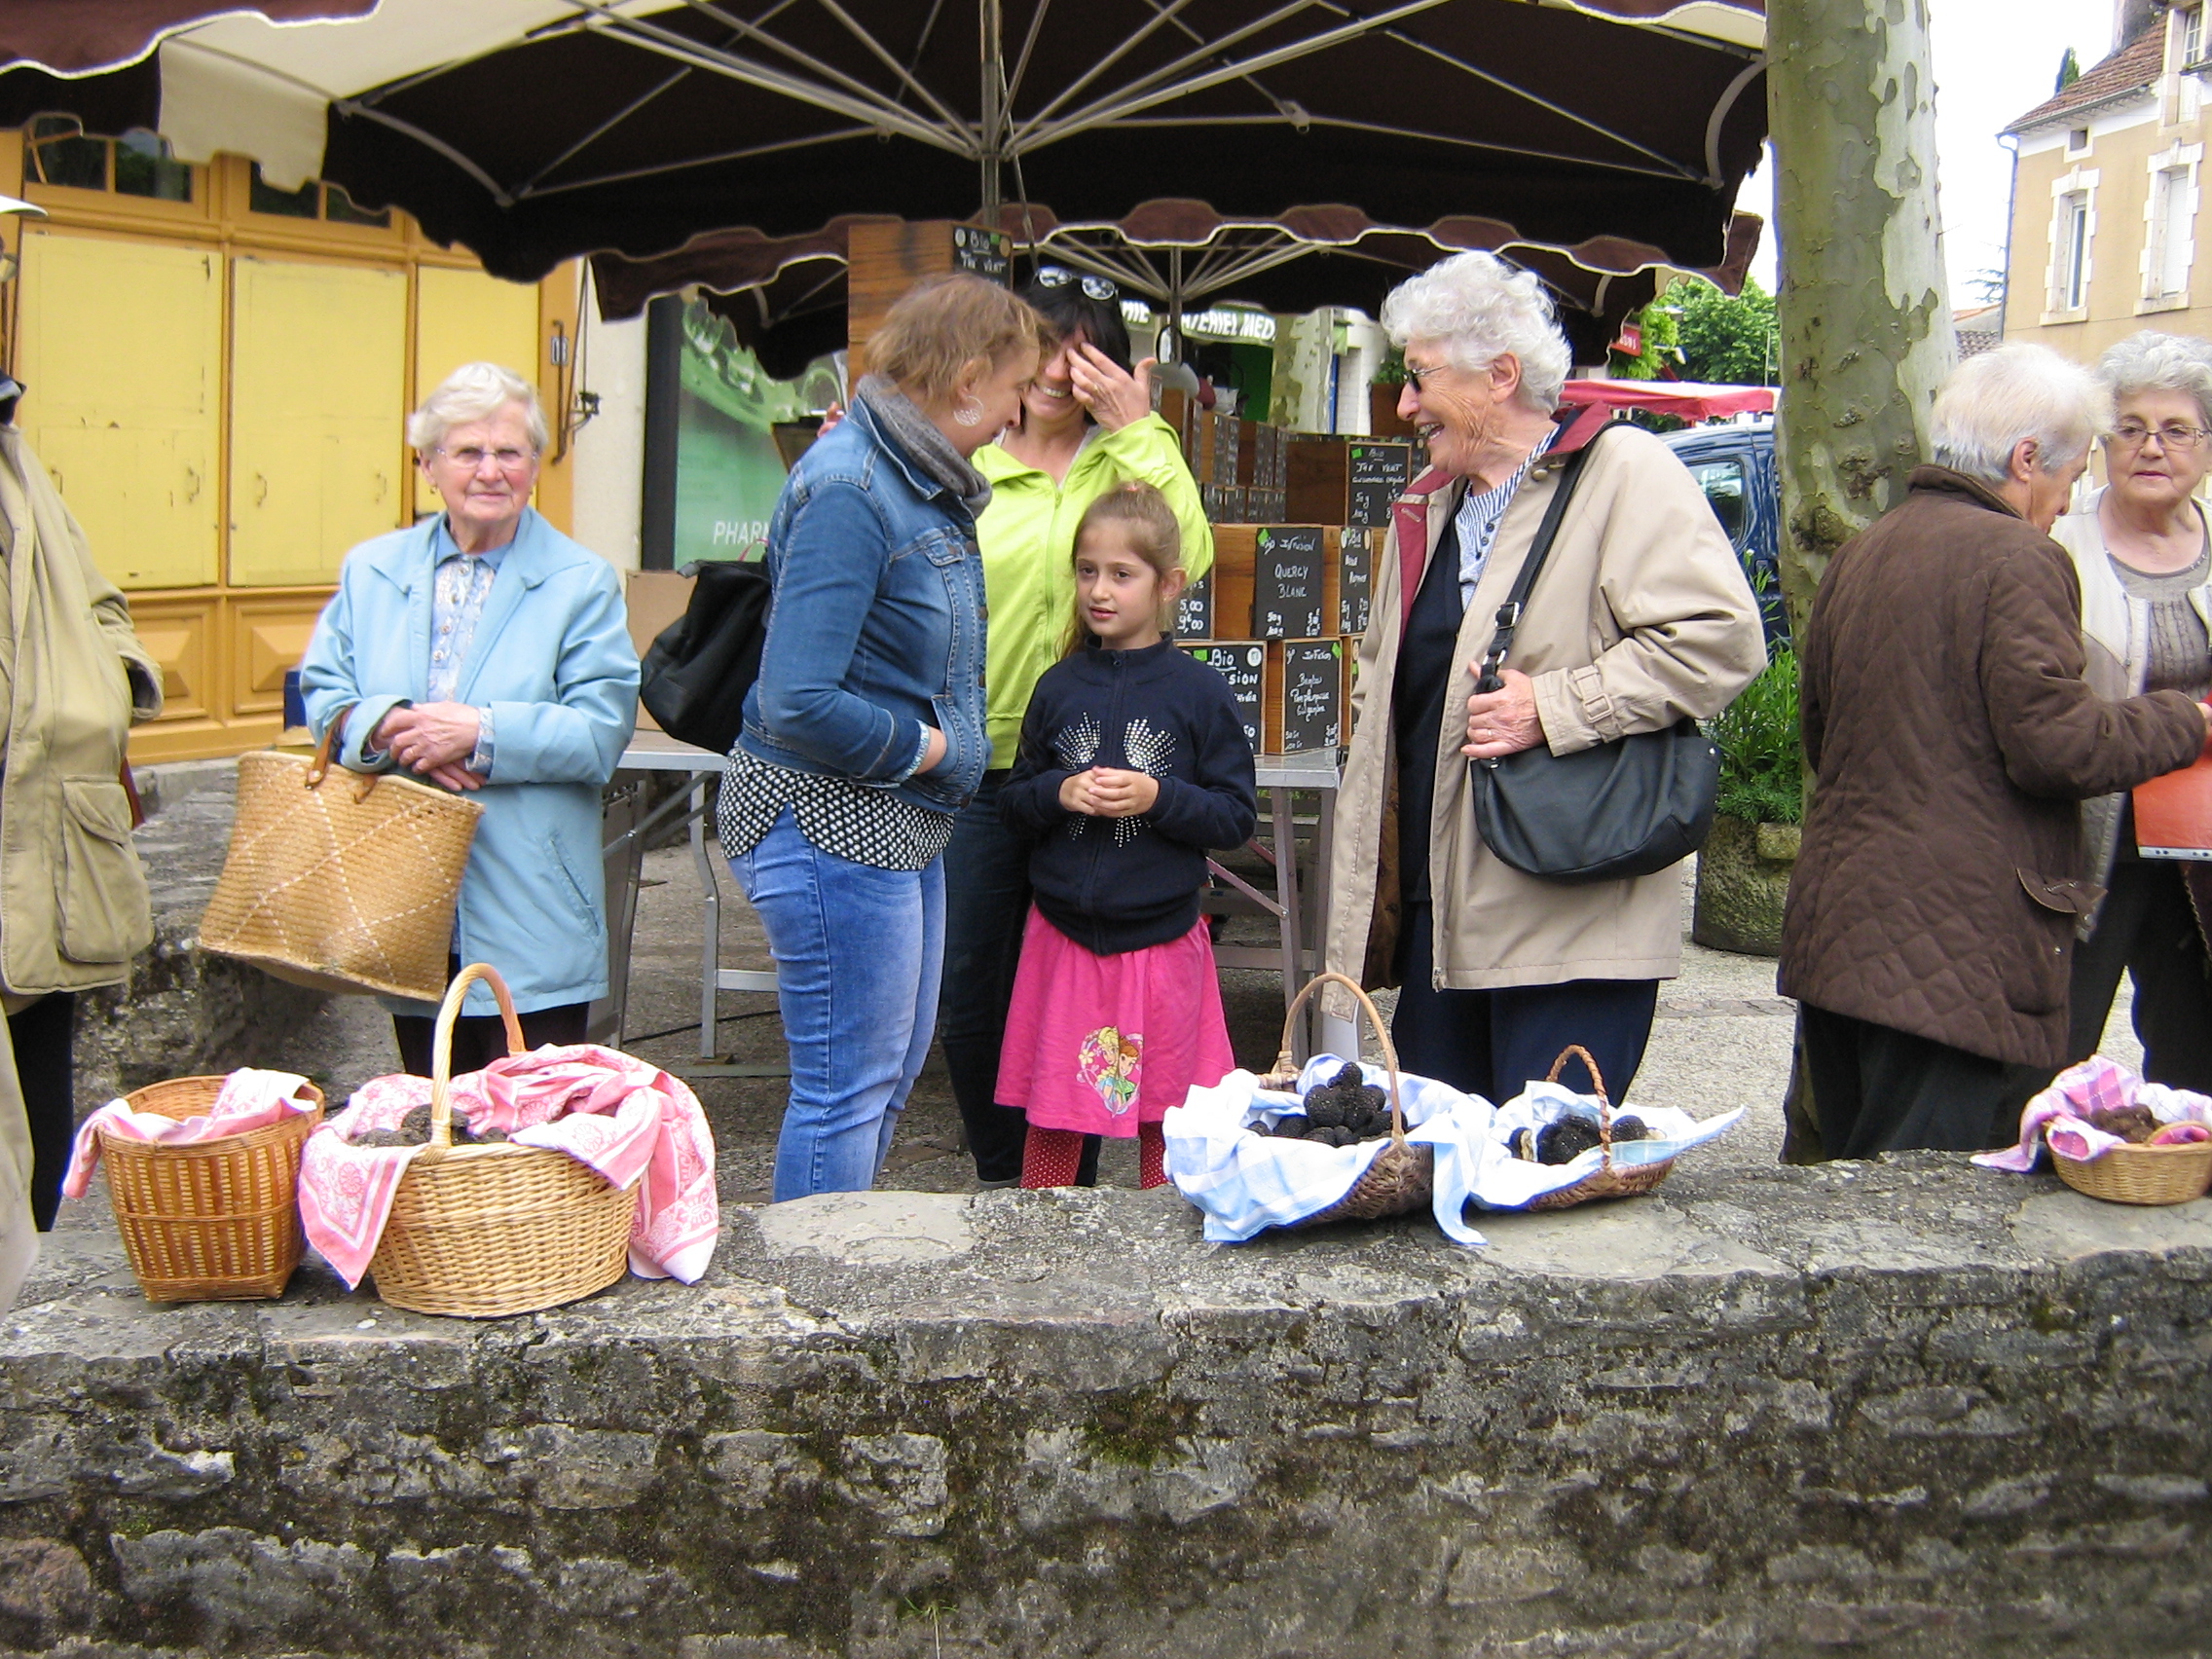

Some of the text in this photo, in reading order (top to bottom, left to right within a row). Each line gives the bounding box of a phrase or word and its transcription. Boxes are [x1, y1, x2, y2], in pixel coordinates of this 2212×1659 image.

[1274, 563, 1309, 580] QUERCY
[1277, 583, 1308, 599] BLANC
[1206, 648, 1235, 667] Bio
